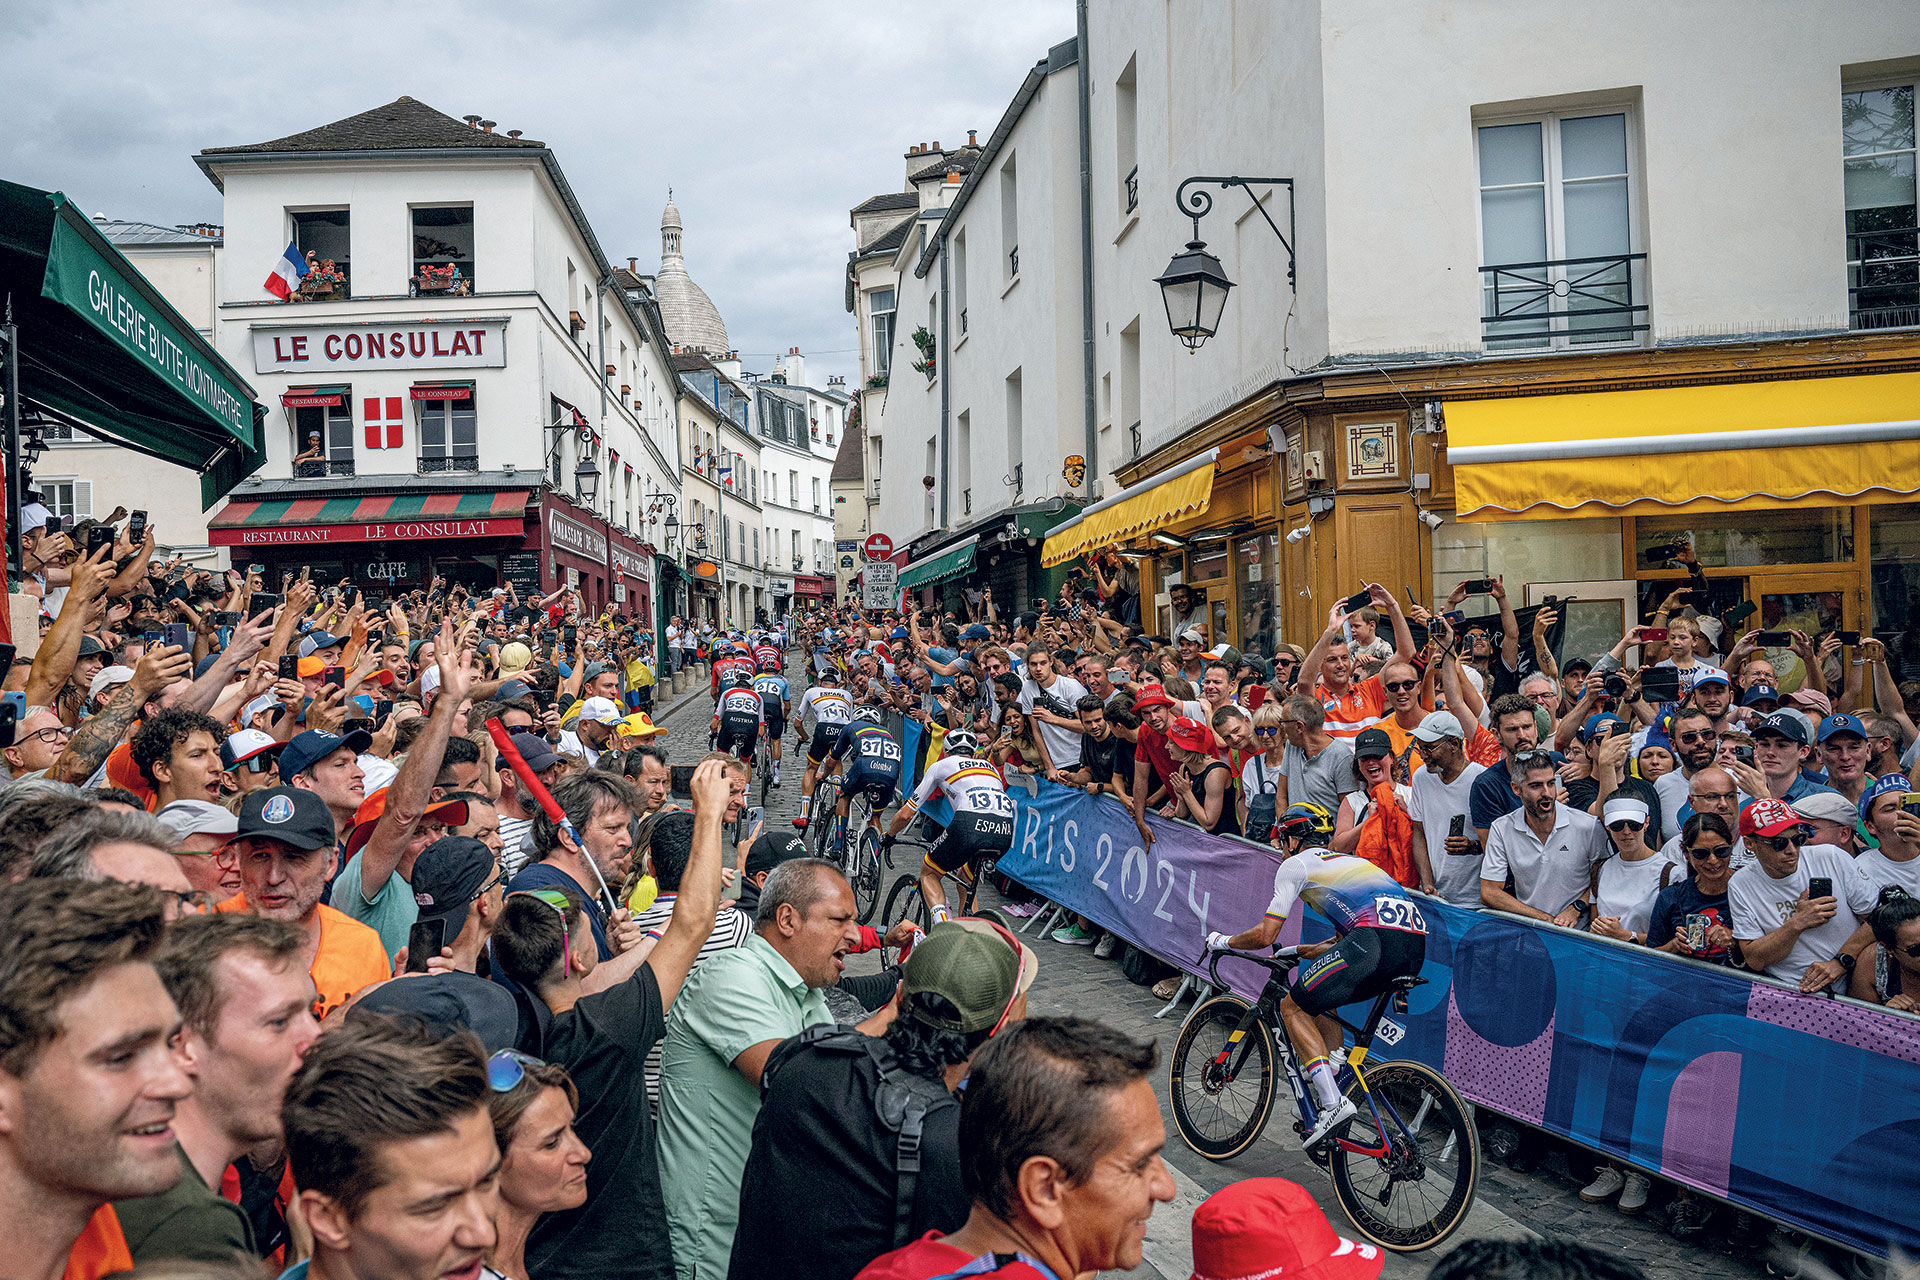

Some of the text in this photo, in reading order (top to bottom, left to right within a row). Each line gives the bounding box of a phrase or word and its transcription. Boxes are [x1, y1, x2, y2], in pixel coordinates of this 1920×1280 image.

[88, 270, 243, 430] GALERIE BUTTE MONTMARTRE
[273, 329, 487, 363] LE CONSULAT
[428, 390, 462, 398] CONSULAT
[242, 529, 331, 543] RESTAURANT
[365, 521, 489, 539] LE CONSULAT
[722, 670, 734, 678] 67
[757, 683, 779, 692] 6 6
[727, 699, 757, 712] 55 55
[823, 707, 838, 718] 14
[729, 716, 754, 724] AUSTRIA
[861, 741, 900, 757] 37 37
[870, 760, 892, 772] Colombia
[968, 793, 991, 808] 13
[995, 794, 1014, 812] 13
[974, 818, 1012, 835] ESPAÑA
[1092, 833, 1211, 937] 2024
[1301, 950, 1341, 982] VENEZUELA
[1381, 1023, 1398, 1042] 62
[1271, 1027, 1304, 1099] MMR
[1247, 1266, 1283, 1280] together
